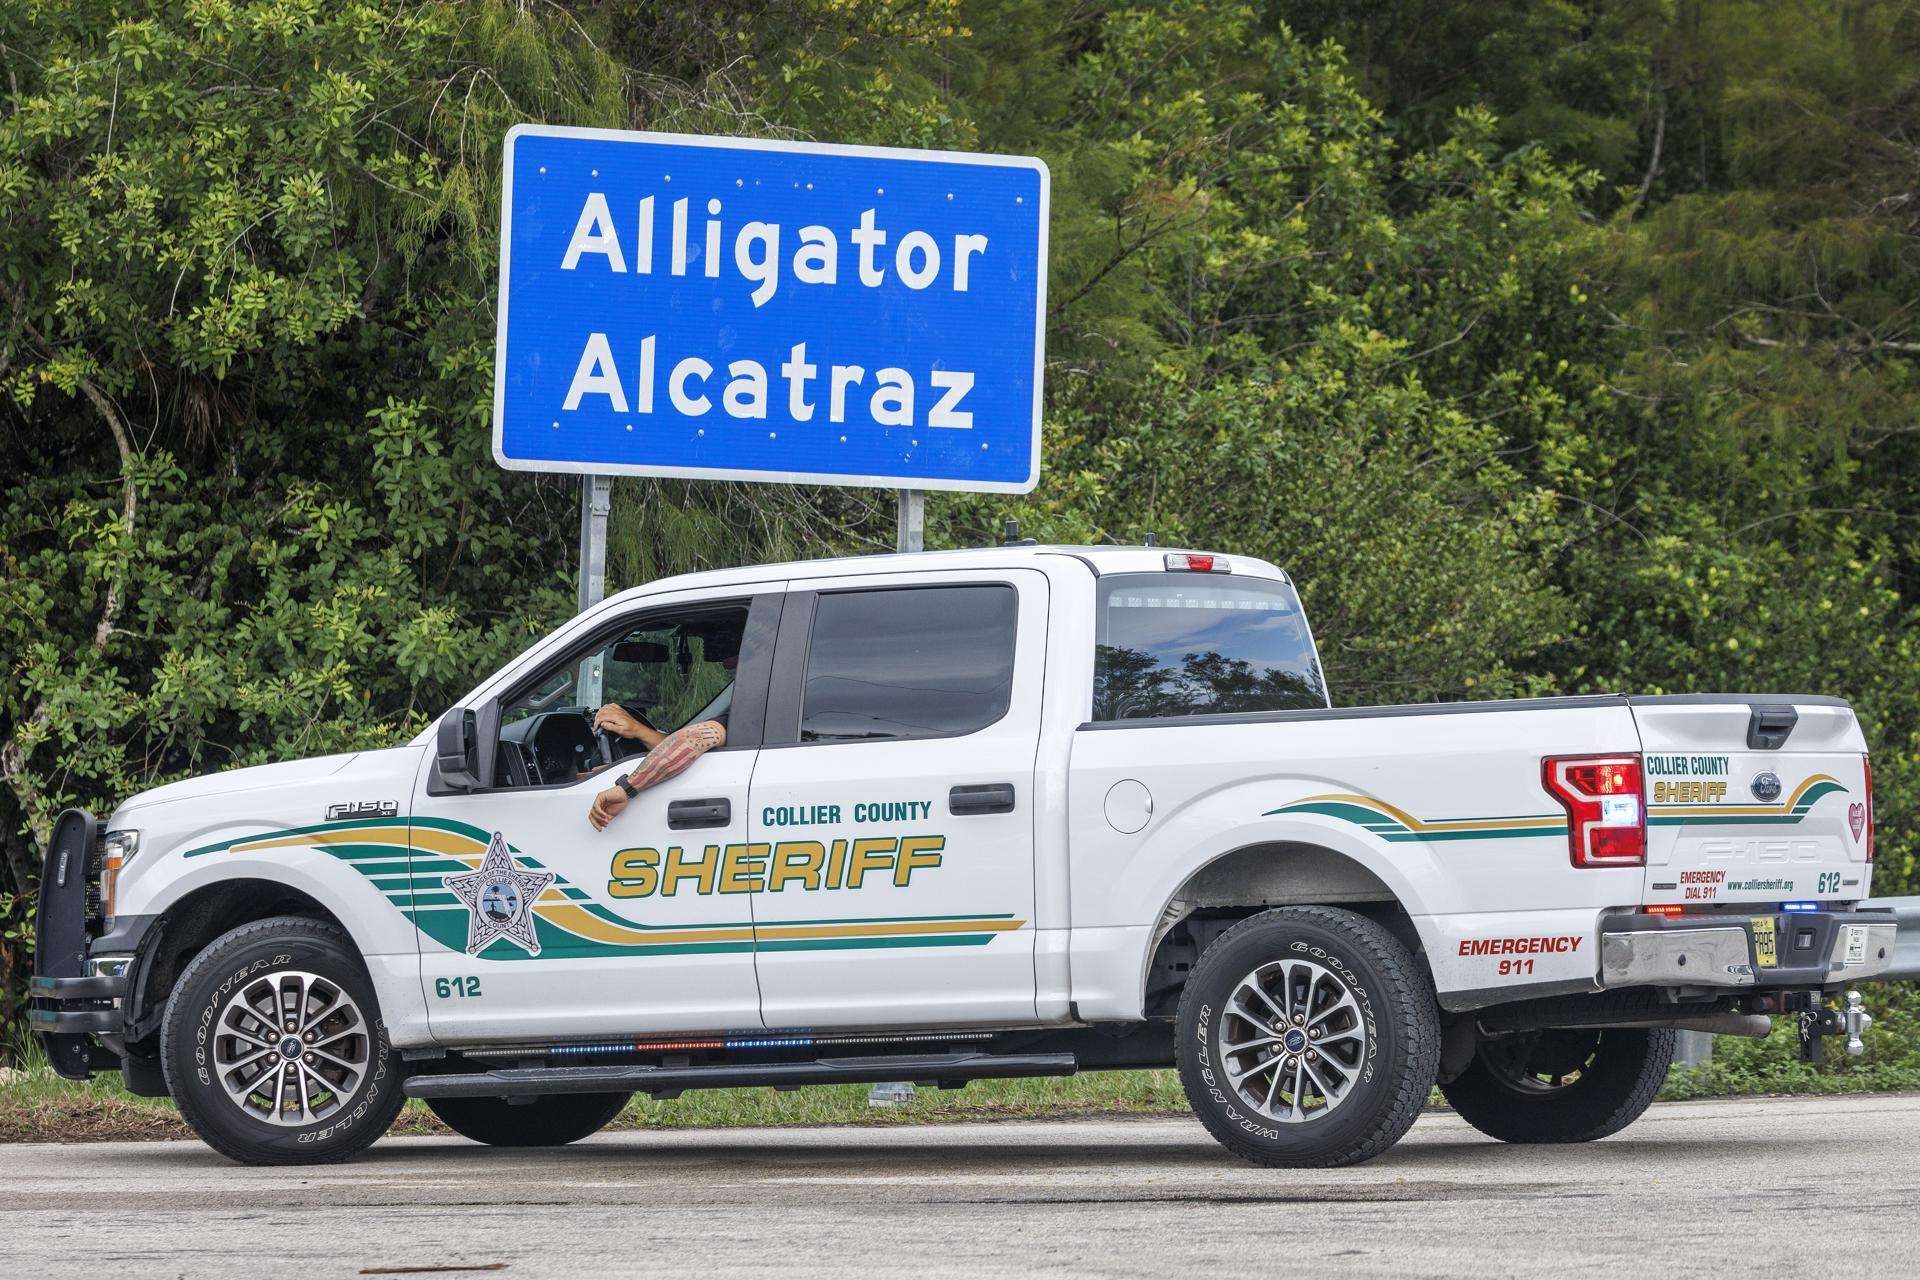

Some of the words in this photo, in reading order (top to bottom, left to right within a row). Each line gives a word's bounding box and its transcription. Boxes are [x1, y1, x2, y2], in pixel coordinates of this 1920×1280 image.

[560, 192, 989, 309] Alligator
[561, 332, 976, 430] Alcatraz
[1647, 756, 1689, 775] COLLIER
[1691, 756, 1729, 775] COUNTY
[1653, 781, 1727, 803] SHERIFF
[1758, 776, 1779, 794] Ford
[762, 803, 841, 827] COLLIER
[854, 801, 932, 823] COUNTY
[607, 835, 946, 899] SHERIFF
[1680, 870, 1727, 884] EMERGENCY
[486, 878, 512, 887] COLLIER
[1685, 887, 1702, 899] DIAL
[1703, 886, 1717, 899] 911
[1727, 878, 1794, 891] www.colliersheriff.org
[1818, 872, 1840, 893] 612
[488, 920, 513, 928] COUNTY
[1458, 936, 1582, 956] EMERGENCY
[1498, 959, 1534, 975] 911
[435, 976, 482, 998] 612
[195, 954, 291, 1086] GOODYEAR
[1290, 941, 1377, 1084] GOODYEAR
[297, 1018, 389, 1143] WRANGLER
[1197, 1004, 1278, 1140] WRANGLER
